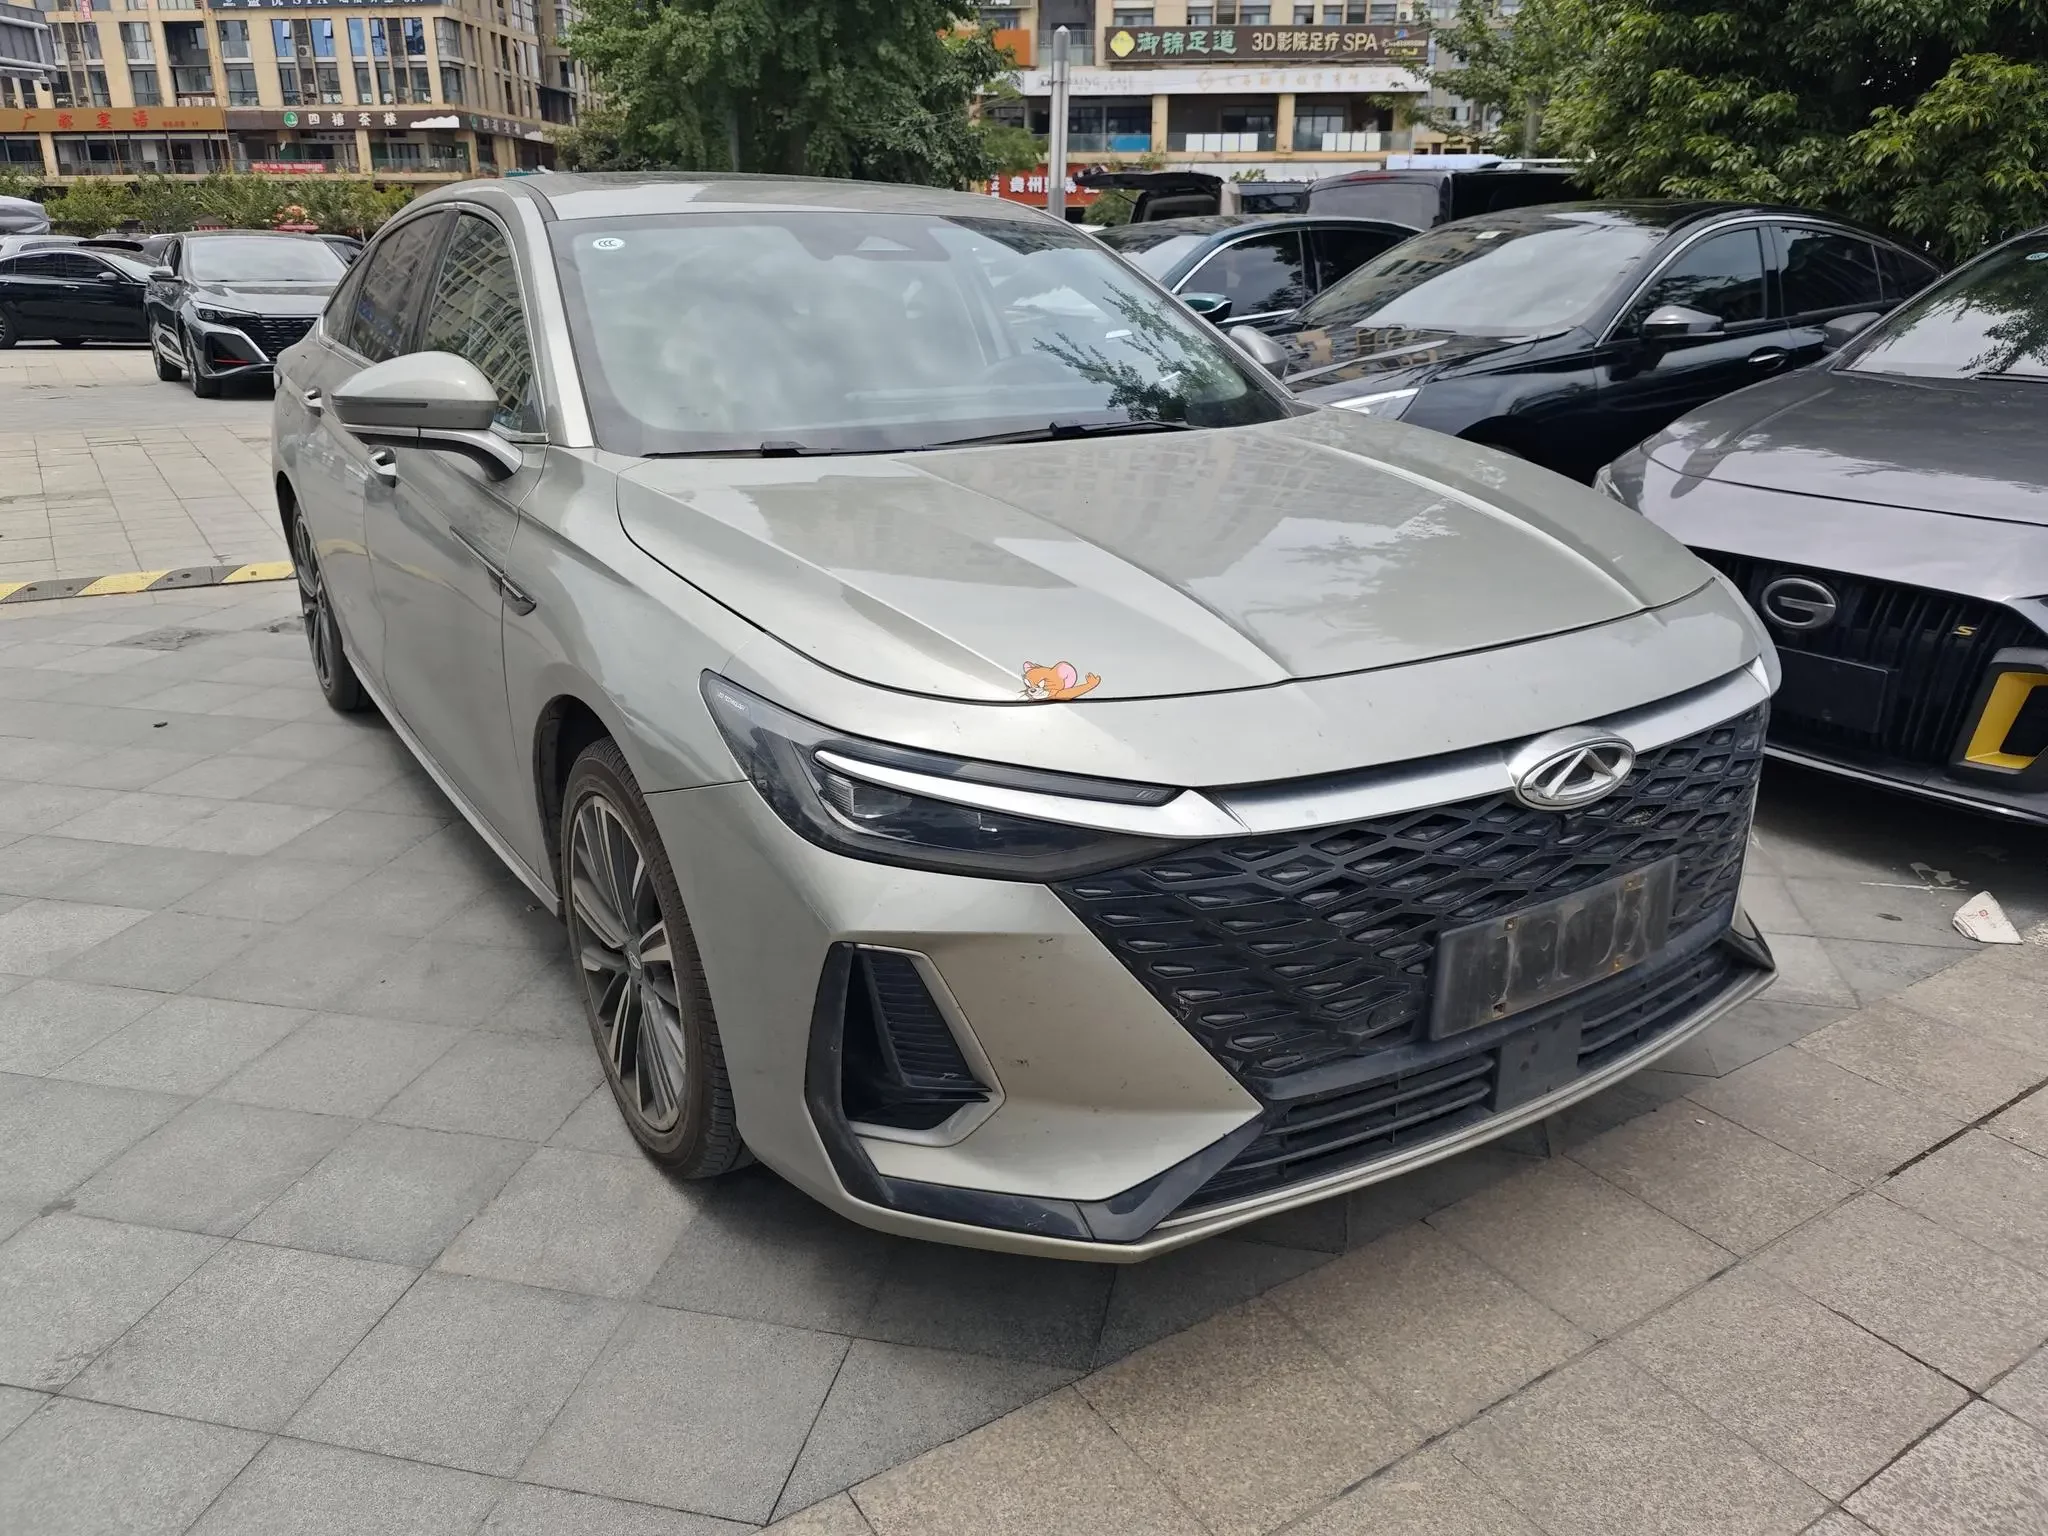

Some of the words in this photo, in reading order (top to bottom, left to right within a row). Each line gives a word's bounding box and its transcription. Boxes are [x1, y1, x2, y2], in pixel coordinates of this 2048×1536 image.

[1252, 31, 1340, 52] 3D影院足疗
[1342, 33, 1378, 51] SPA
